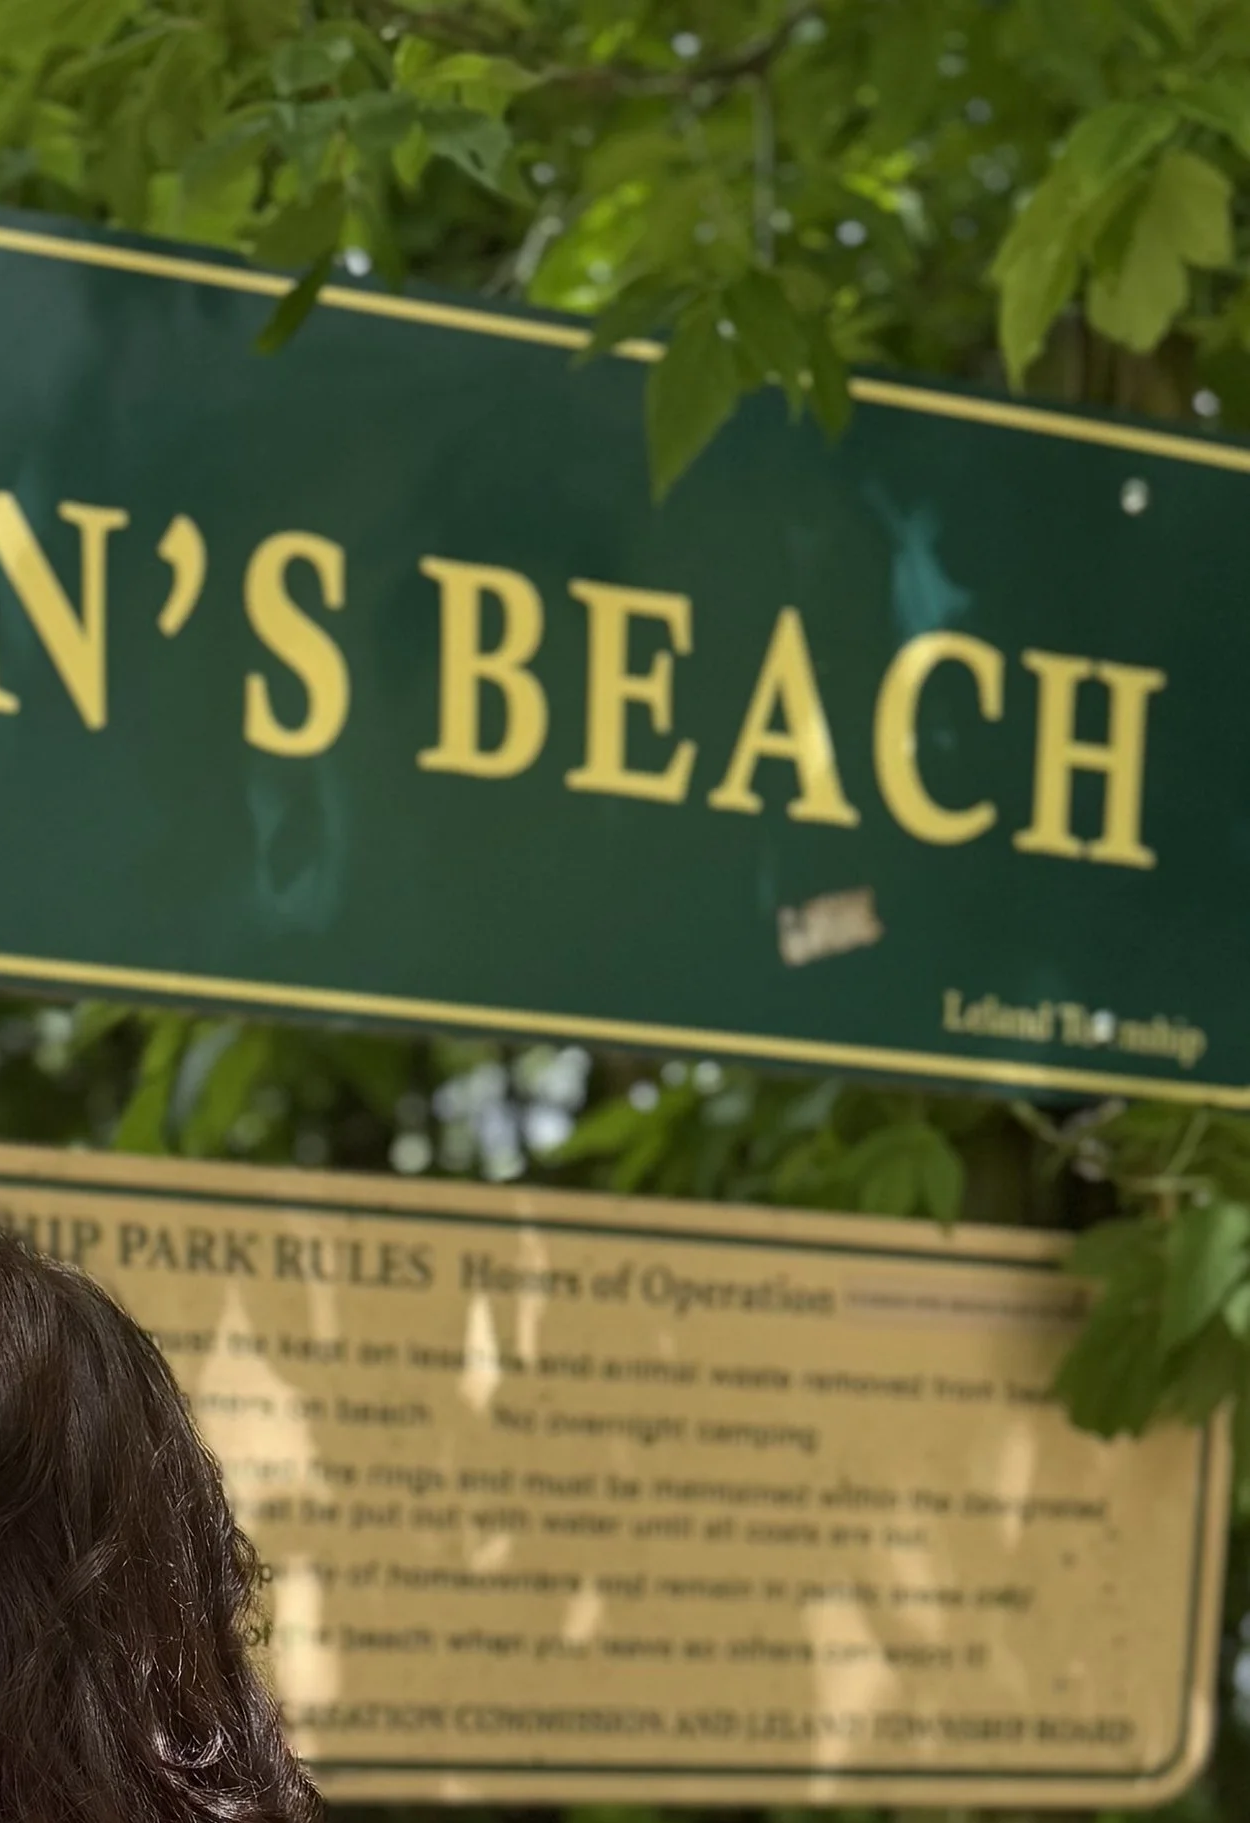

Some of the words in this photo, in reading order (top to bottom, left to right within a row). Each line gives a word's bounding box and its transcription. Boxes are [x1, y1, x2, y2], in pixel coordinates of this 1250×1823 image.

[416, 555, 1167, 868] BEACH
[943, 988, 1052, 1042] Leland
[1058, 1001, 1207, 1069] Tonship
[117, 1220, 258, 1279] PARK
[273, 1231, 434, 1292] RULES
[461, 1252, 582, 1296] Hours
[591, 1262, 633, 1300] of
[641, 1264, 836, 1318] Operation
